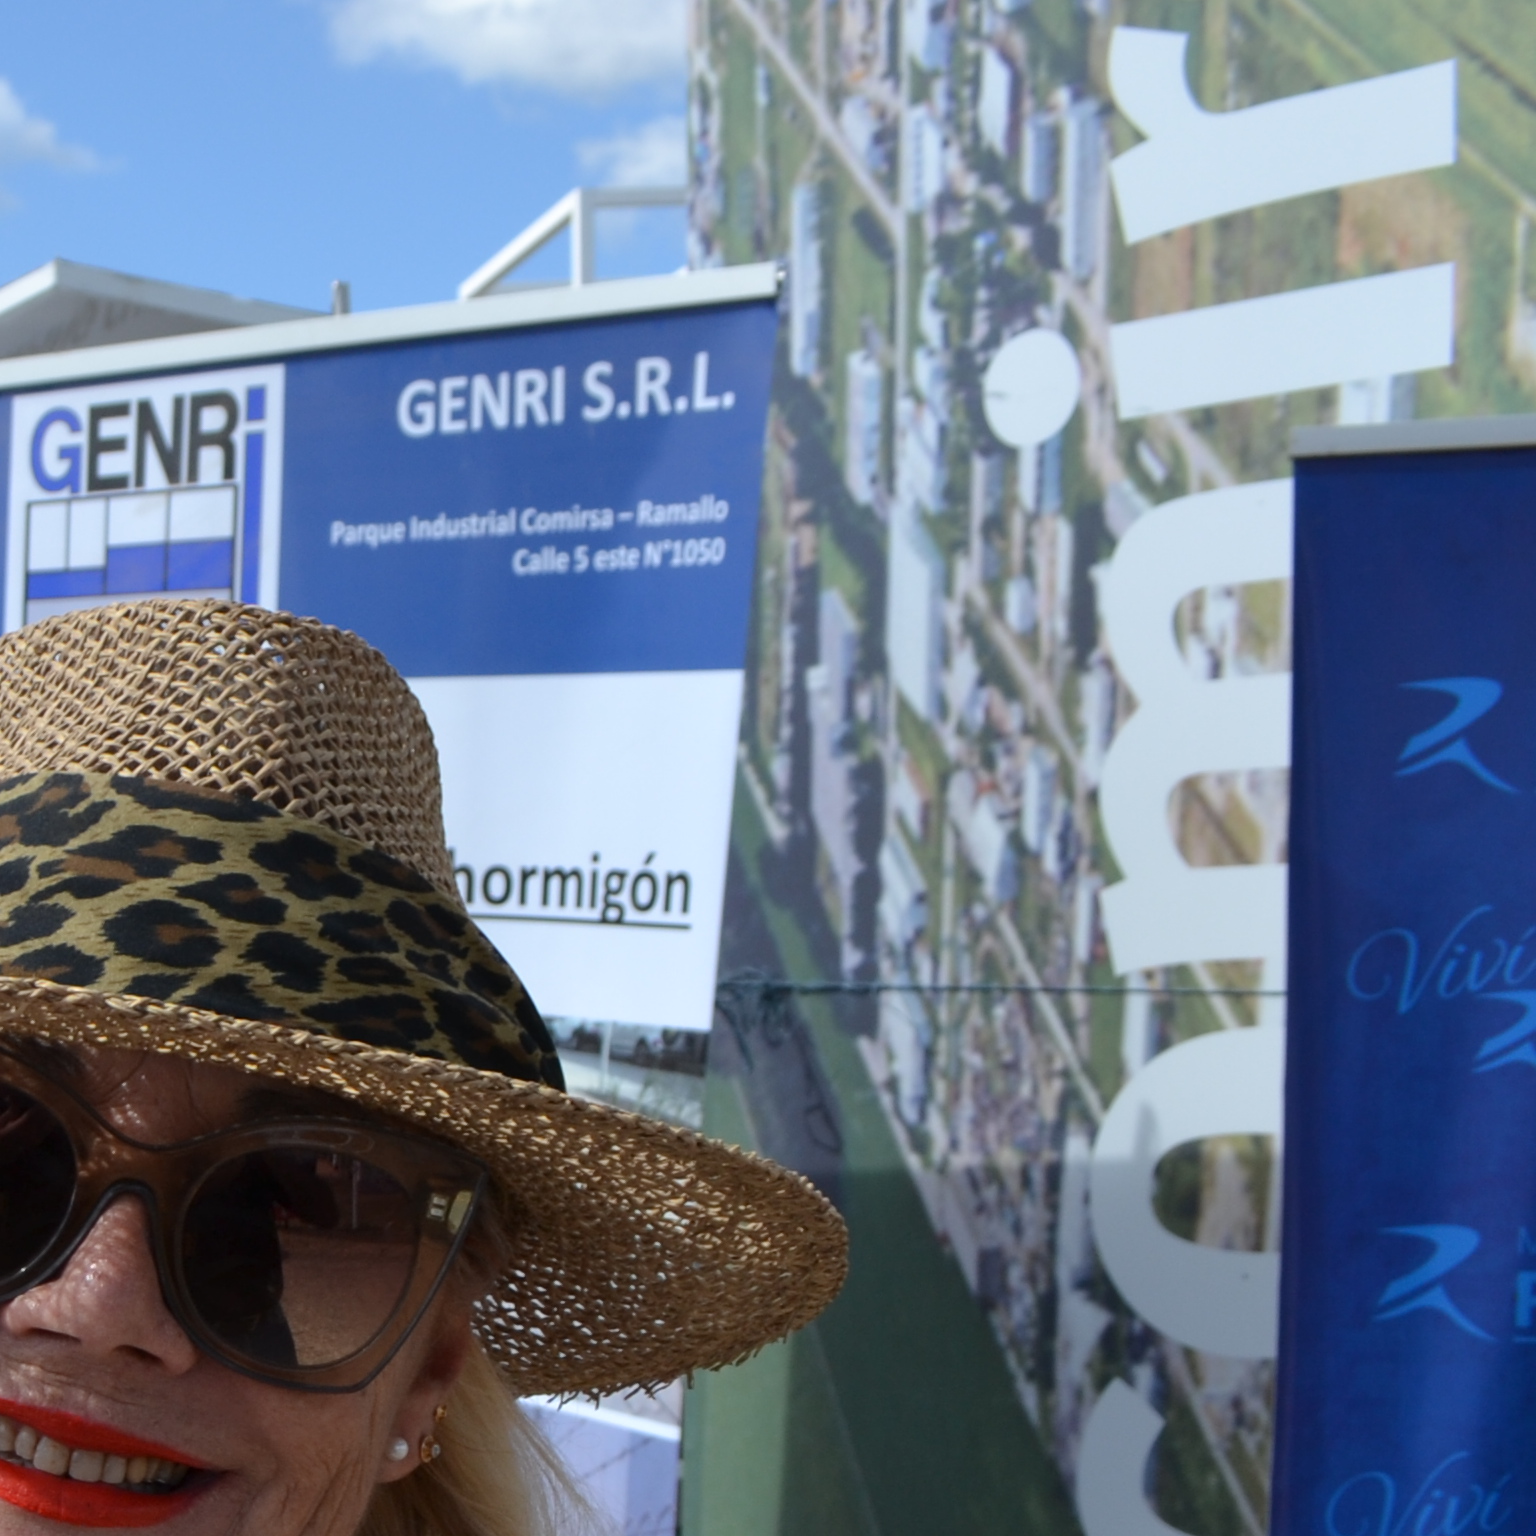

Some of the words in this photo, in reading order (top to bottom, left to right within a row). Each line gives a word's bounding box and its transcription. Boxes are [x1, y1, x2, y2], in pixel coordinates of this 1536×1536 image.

[396, 365, 567, 438] GENRI
[581, 351, 736, 422] S.R.L.
[330, 519, 407, 549] Parque
[409, 508, 516, 541] Industrial
[519, 503, 614, 535] Comirsa
[635, 495, 729, 527] Ramallo
[512, 545, 570, 576] Calle
[573, 545, 590, 573] 5
[593, 544, 640, 573] este
[643, 536, 726, 567] N°1050
[446, 847, 691, 923] hormigón
